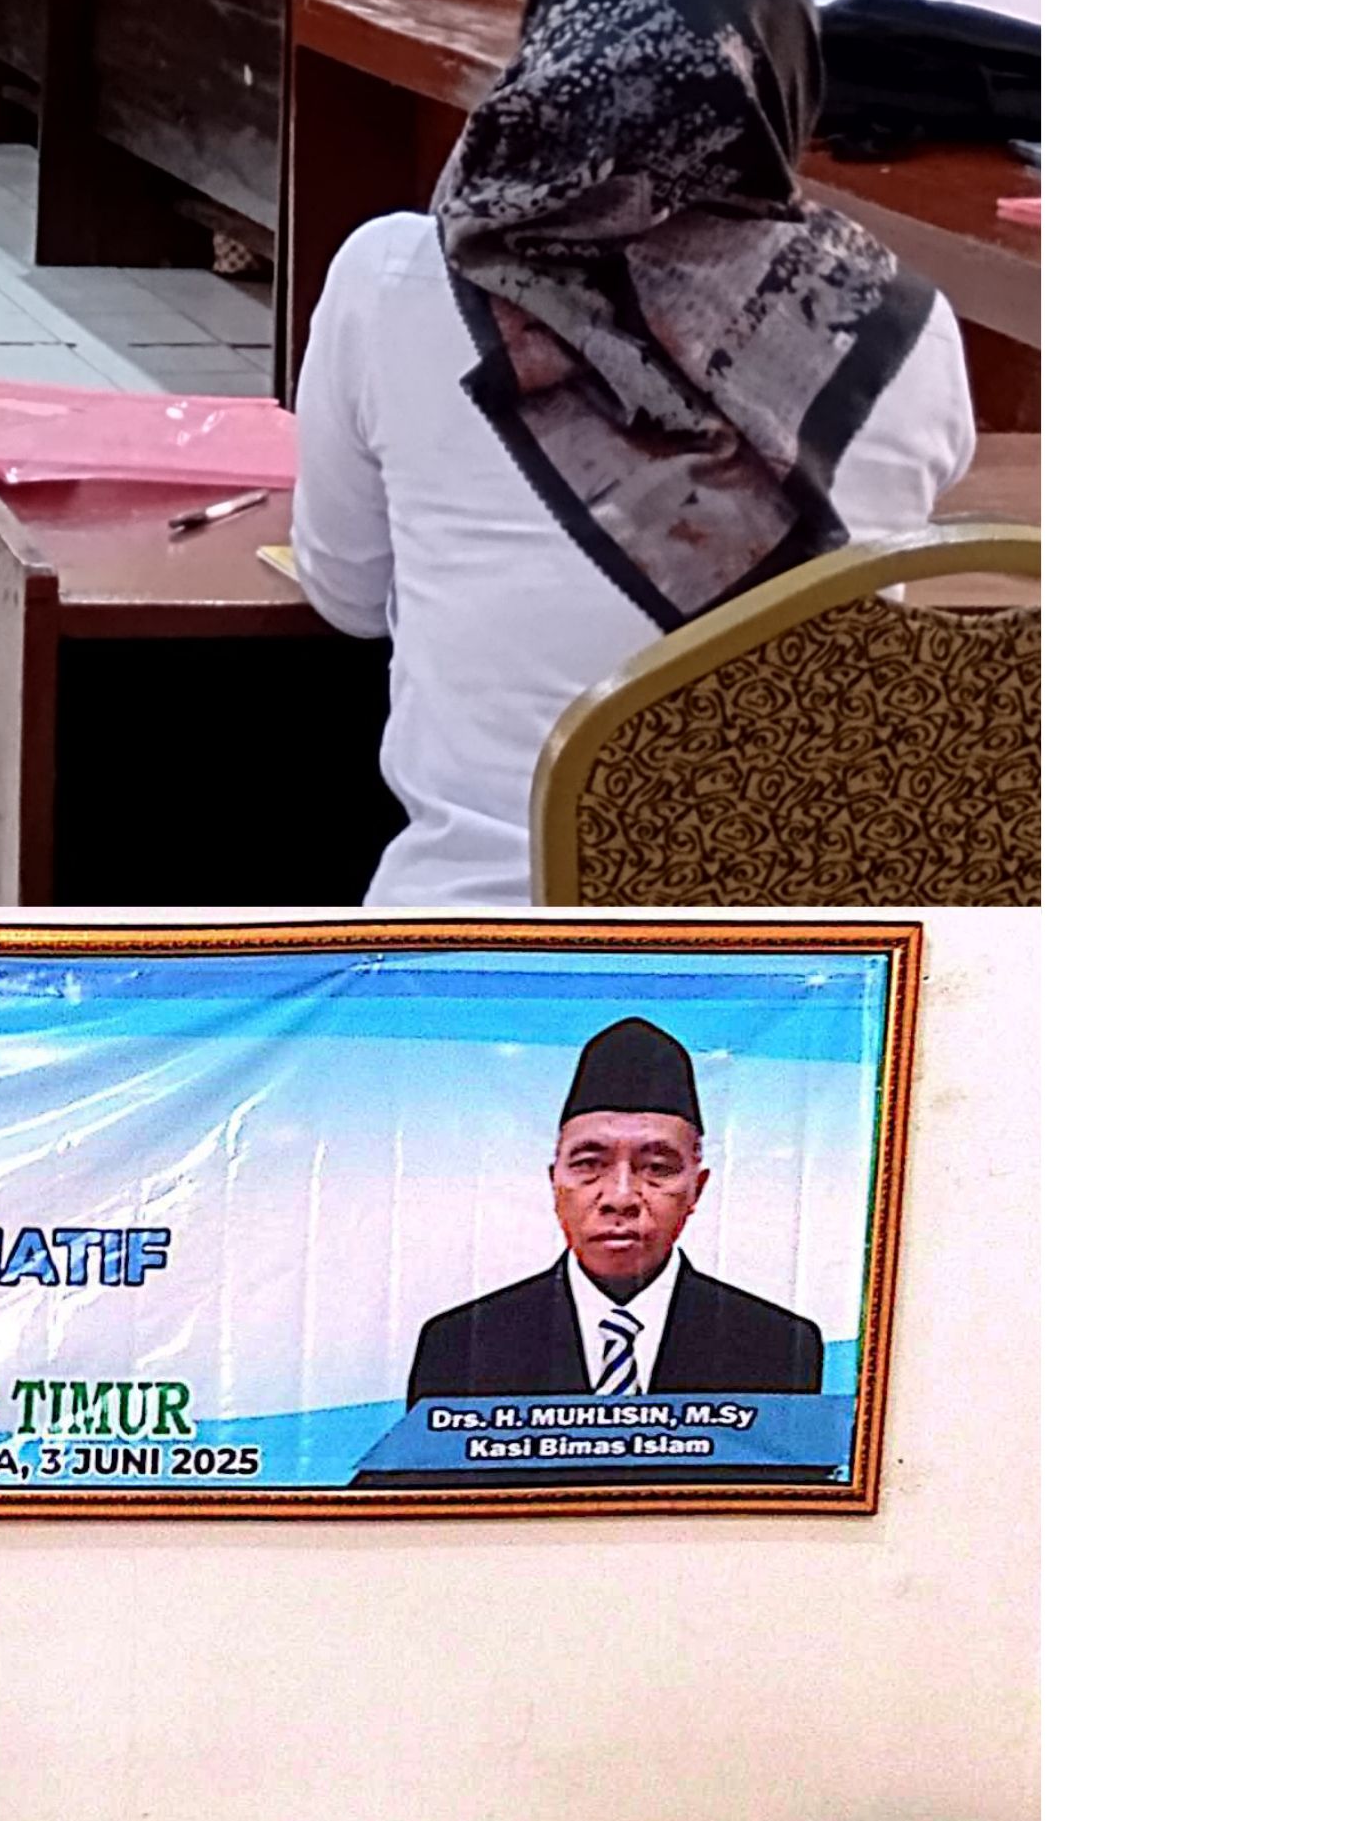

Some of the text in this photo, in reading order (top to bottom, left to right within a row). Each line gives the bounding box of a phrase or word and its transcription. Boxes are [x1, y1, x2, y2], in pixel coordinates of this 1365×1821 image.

[11, 1380, 192, 1437] TIMUR
[432, 1405, 755, 1429] Drs. H. MUHLISIN, M.Sy
[469, 1436, 710, 1457] Kasi Bimas Islam
[40, 1447, 62, 1475] 3
[72, 1447, 160, 1475] JUNI
[171, 1447, 259, 1475] 2025
